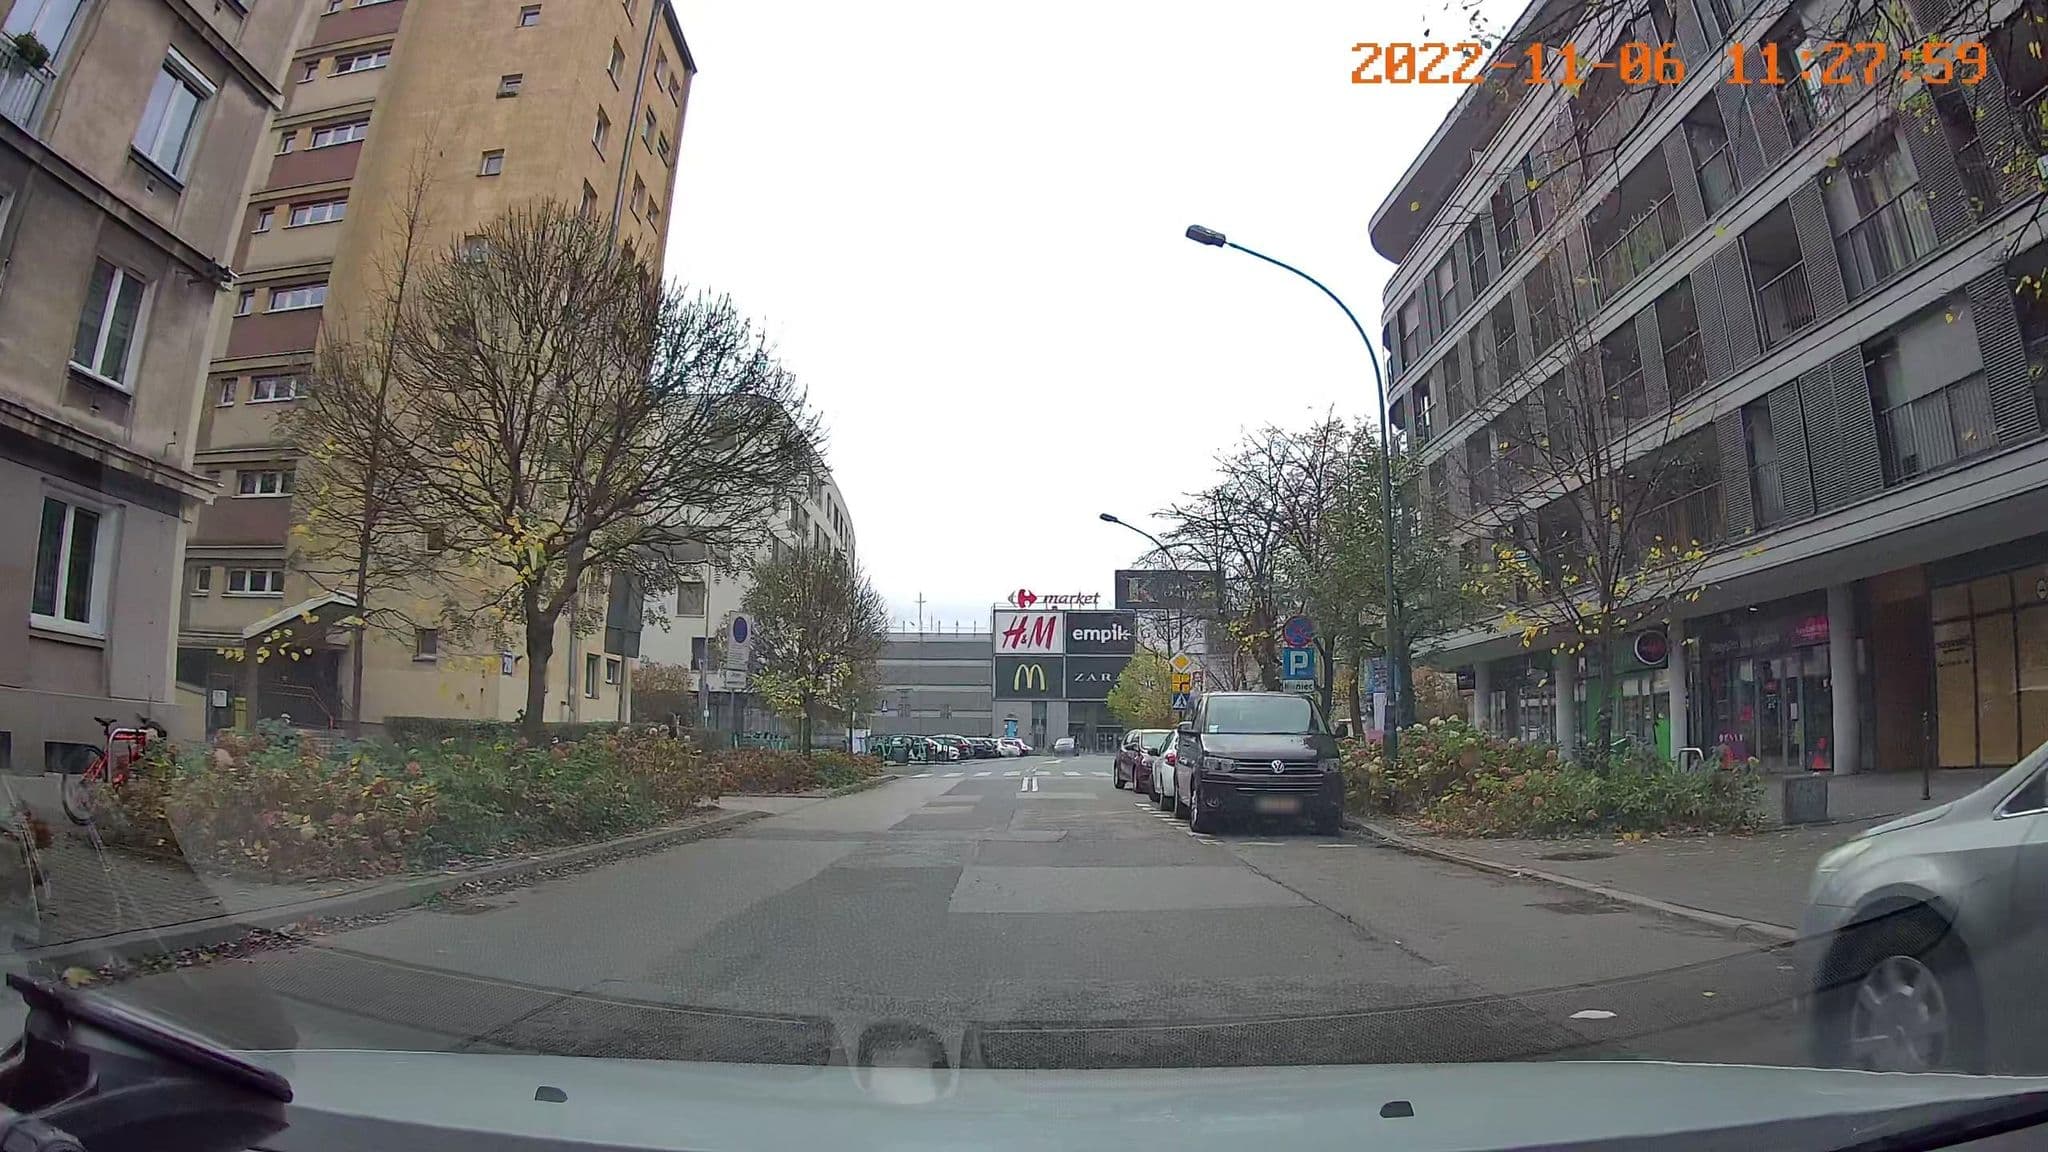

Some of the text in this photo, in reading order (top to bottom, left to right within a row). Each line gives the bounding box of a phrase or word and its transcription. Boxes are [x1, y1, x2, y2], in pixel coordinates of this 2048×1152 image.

[1043, 592, 1101, 606] market
[1002, 615, 1057, 651] H&M
[1072, 623, 1131, 644] empik
[1290, 650, 1309, 676] P
